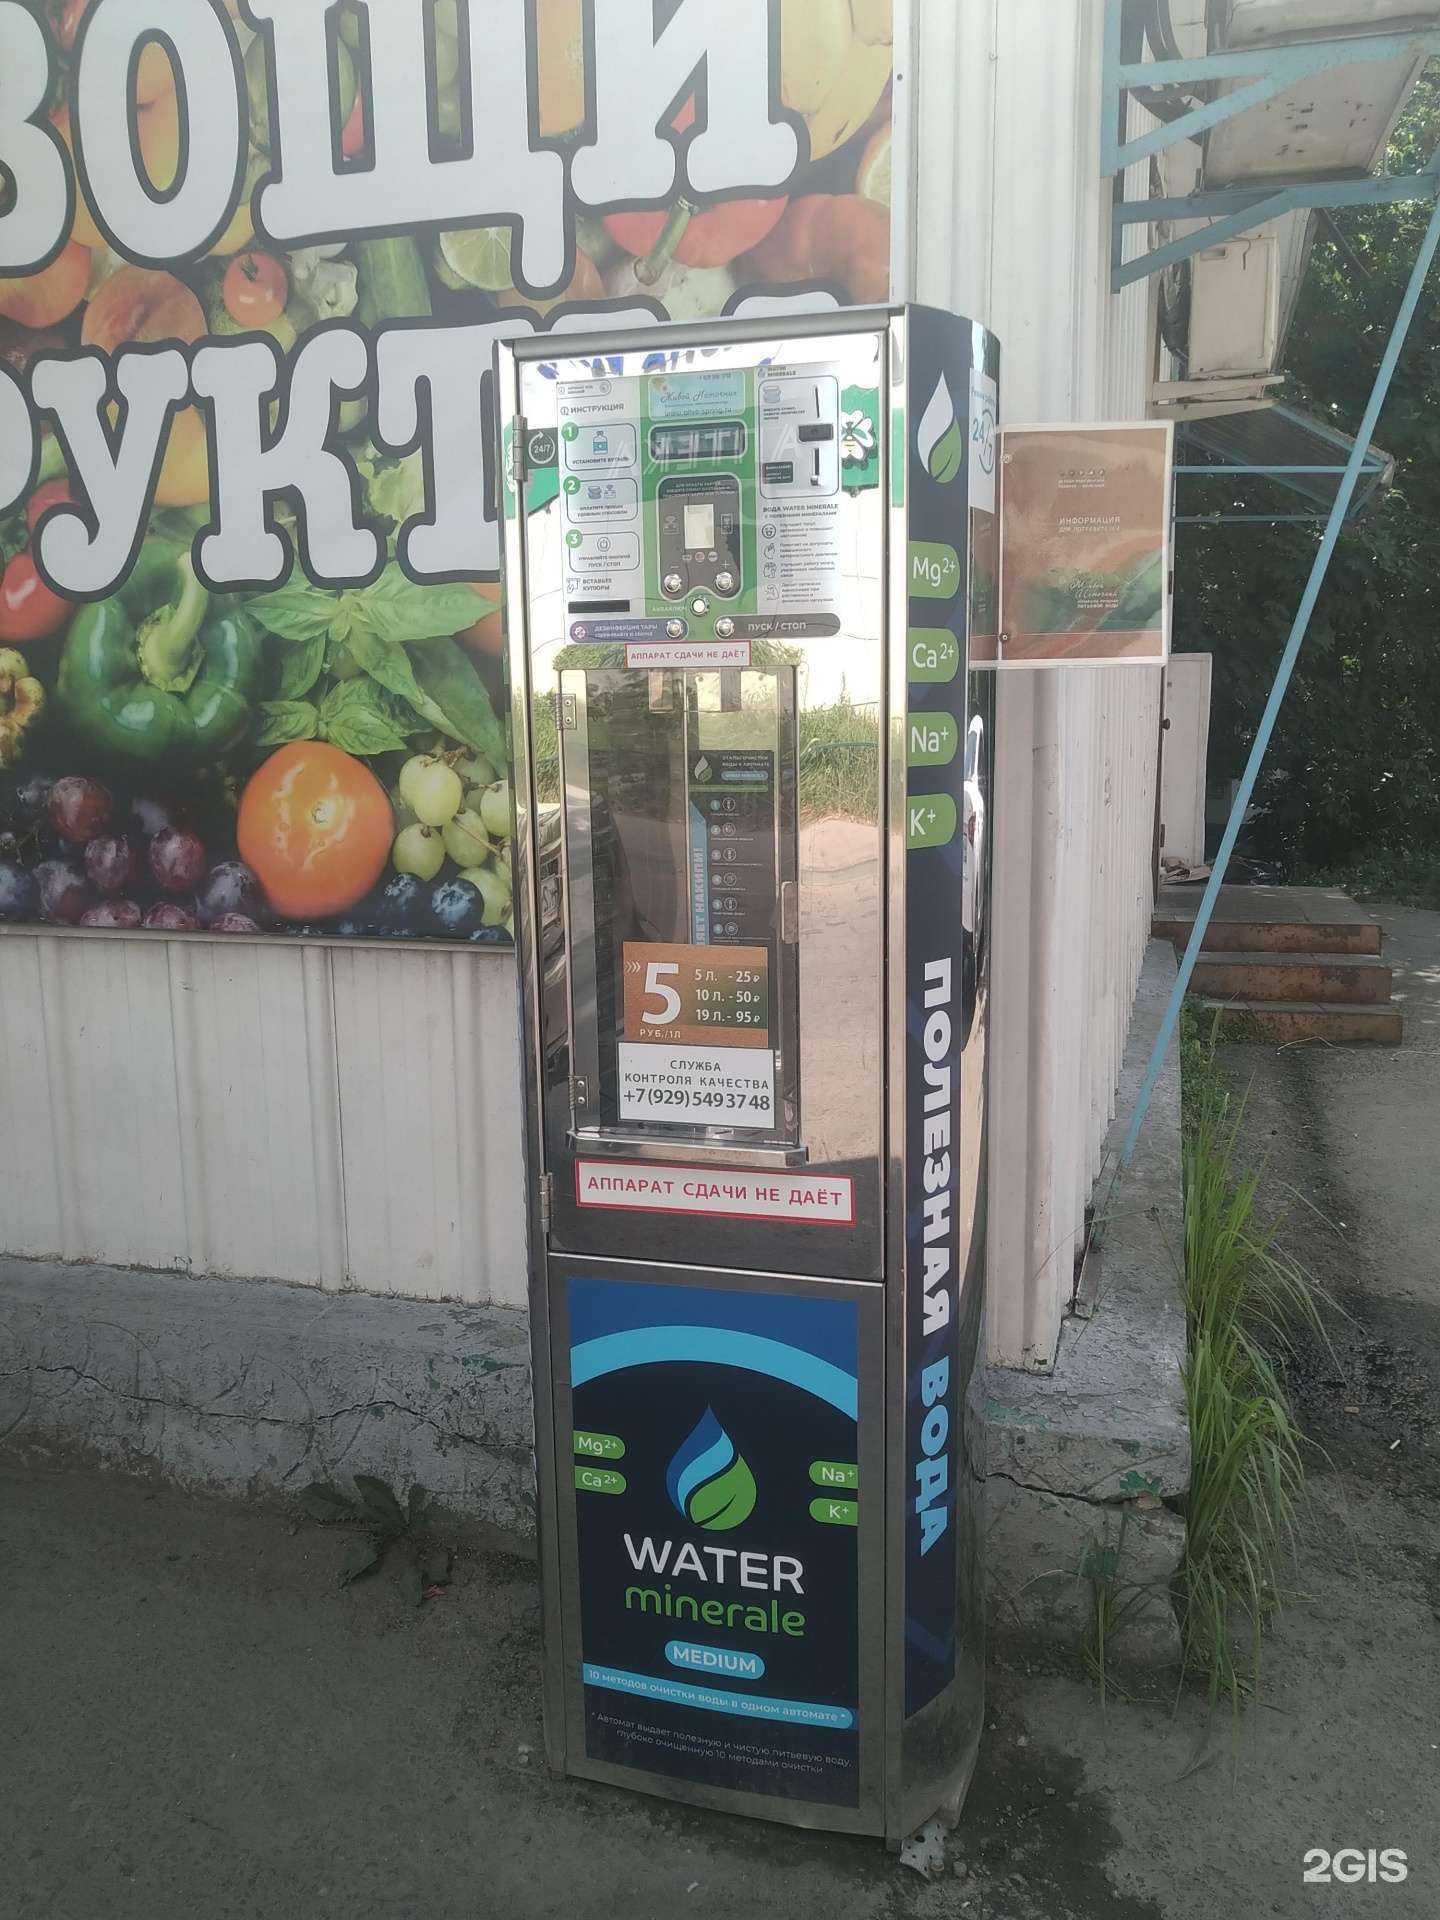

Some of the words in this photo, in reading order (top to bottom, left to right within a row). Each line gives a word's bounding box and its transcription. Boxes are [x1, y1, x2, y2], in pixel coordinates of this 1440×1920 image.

[570, 403, 625, 414] ИНСТРУКЦИЯ
[567, 426, 572, 438] 1
[0, 286, 848, 598] УКТ
[534, 444, 551, 454] 24/7
[567, 480, 576, 491] 2
[1058, 516, 1120, 525] ИНФОРМАЦИЯ
[570, 533, 579, 545] 3
[748, 623, 773, 632] ПУСК
[781, 621, 806, 630] СТОП
[631, 652, 671, 660] АППАРАТ
[674, 651, 704, 661] СДАЧИ
[707, 651, 718, 659] НЕ
[721, 650, 746, 660] ДАЁТ
[695, 969, 702, 981] 5
[642, 962, 682, 1025] 5
[695, 989, 709, 1001] 10
[696, 1009, 710, 1022] 19
[670, 1060, 721, 1072] СЛУЖБА
[624, 1072, 692, 1086] КОНТРОЛЯ
[699, 1076, 769, 1090] КАЧЕСТВА
[923, 957, 952, 1336] ПОЛЕЗНАЯ
[587, 1176, 674, 1195] АППАРАТ
[683, 1182, 747, 1200] СДАЧИ
[755, 1187, 781, 1202] НЕ
[788, 1190, 843, 1207] ДАЁТ
[915, 1354, 950, 1557] ВОДА
[623, 1533, 805, 1595] WATER
[624, 1584, 807, 1637] minerale
[673, 1645, 757, 1674] MEDIUM
[590, 1669, 600, 1680] 10
[602, 1674, 647, 1690] методов
[650, 1684, 696, 1700] очистки
[698, 1694, 728, 1707] воды
[731, 1699, 738, 1708] в
[741, 1701, 780, 1714] одном
[782, 1707, 839, 1722] автомате
[597, 1712, 635, 1730] Автомат
[637, 1722, 671, 1737] выдает
[673, 1731, 722, 1749] полезную
[724, 1741, 731, 1750] и
[733, 1743, 770, 1759] чистую
[773, 1749, 822, 1766] питьевую
[616, 1728, 654, 1745] глубоко
[655, 1738, 714, 1758] очищенную
[715, 1748, 726, 1759] 10
[729, 1753, 779, 1769] методами
[781, 1762, 823, 1775] очистки
